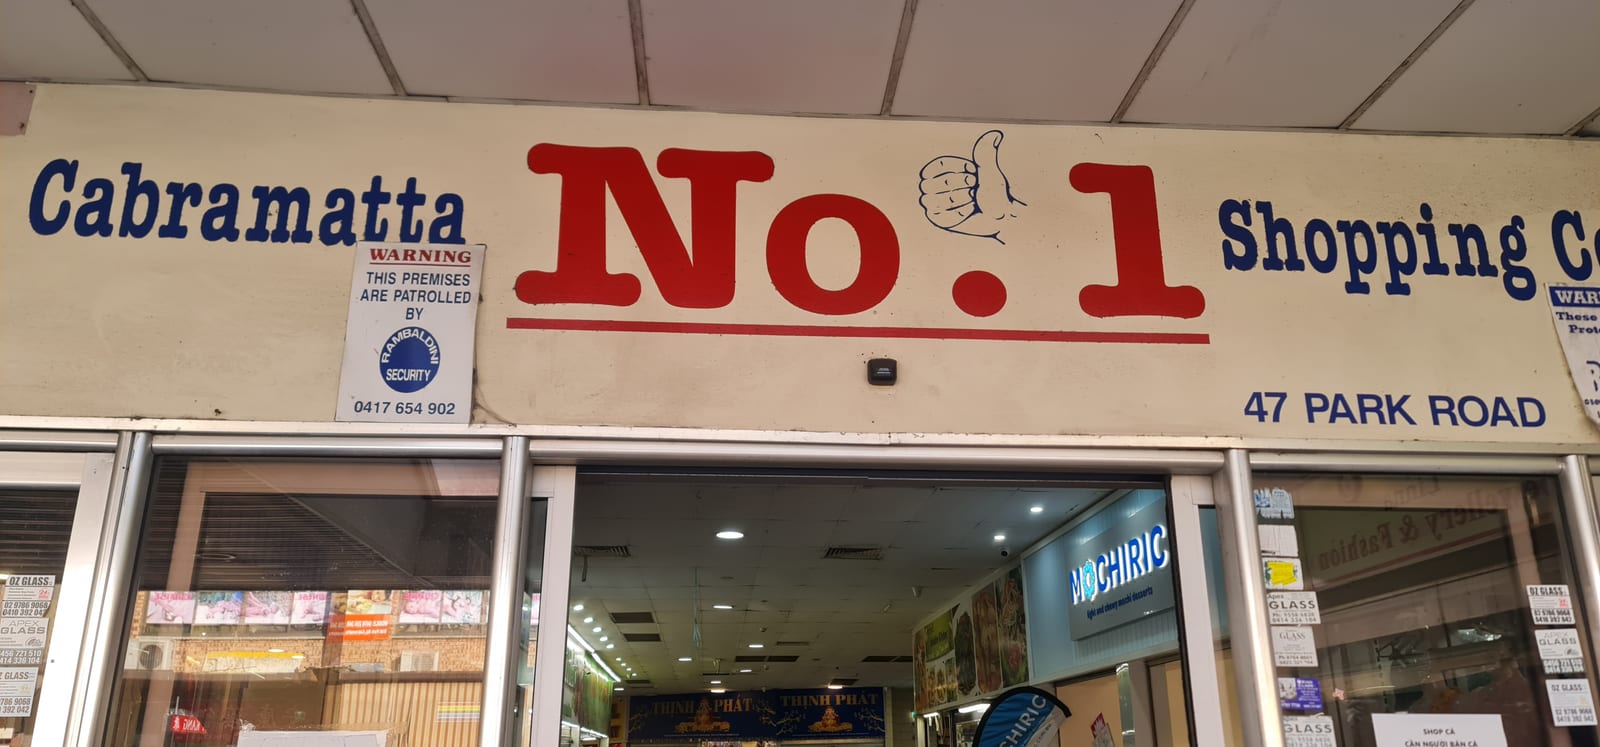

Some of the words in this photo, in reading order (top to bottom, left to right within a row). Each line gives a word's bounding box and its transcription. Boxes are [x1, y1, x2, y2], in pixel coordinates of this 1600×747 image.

[29, 158, 466, 247] Cabramatta
[370, 248, 472, 264] WARNING
[1218, 198, 1537, 301] Shopping
[1551, 209, 1600, 281] C
[366, 271, 397, 285] THIS
[402, 272, 471, 286] PREMISES
[360, 289, 388, 302] ARE
[393, 289, 471, 304] PATROLLED
[1554, 289, 1600, 305] WAR
[405, 307, 424, 320] BY
[1555, 311, 1598, 321] These
[1568, 324, 1600, 334] Prot
[381, 327, 439, 365] RAMBALDINI
[386, 368, 431, 382] SECURITY
[354, 400, 391, 414] 0417
[395, 402, 423, 415] 654
[428, 402, 456, 415] 902
[1244, 391, 1287, 423] 47
[1304, 392, 1416, 426] PARK
[1428, 395, 1546, 428] ROAD
[1069, 524, 1170, 605] MOCHIRIC
[9, 576, 20, 586] OZ
[21, 576, 49, 586] GLASS
[1540, 586, 1564, 596] GLASS
[1268, 600, 1316, 610] GLASS
[9, 619, 40, 627] APEX
[0, 626, 46, 635] GLASS
[1539, 637, 1577, 646] GLASS
[4, 671, 30, 680] GLASS
[1284, 724, 1332, 734] GLASS
